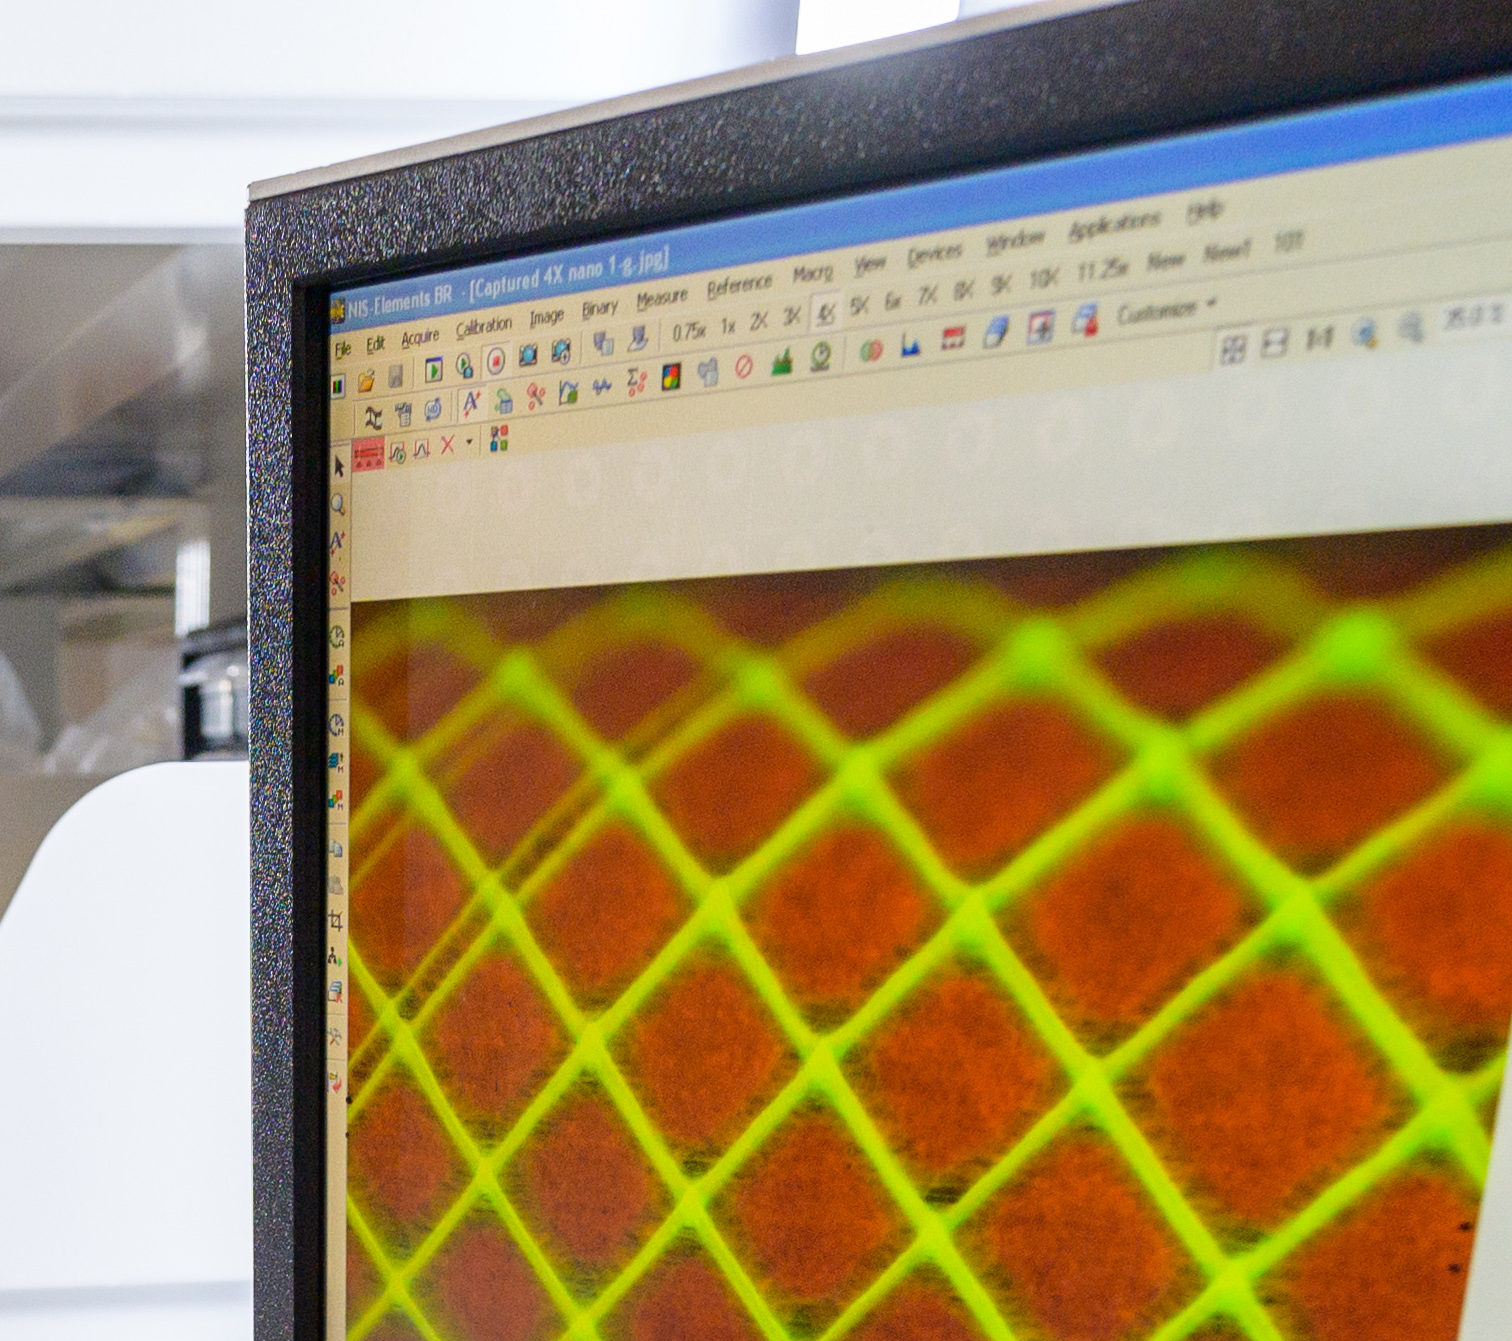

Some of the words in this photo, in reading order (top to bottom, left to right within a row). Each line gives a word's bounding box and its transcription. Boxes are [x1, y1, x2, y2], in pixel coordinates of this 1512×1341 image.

[335, 341, 352, 359] File
[366, 335, 385, 354] Edit
[401, 328, 439, 349] Acquire
[456, 315, 512, 341] Calibration
[530, 308, 564, 329] Image
[582, 298, 619, 321] Binary
[637, 286, 688, 312] Measure
[708, 274, 772, 300] Reference
[793, 264, 834, 284] Macro
[854, 255, 887, 279] View
[907, 242, 963, 268] Devices
[985, 228, 1046, 257] Window
[1067, 209, 1162, 244] Applications
[347, 290, 431, 319] NIS-Elements
[434, 283, 453, 304] BR
[469, 268, 539, 304] [Captured
[543, 264, 563, 284] 4X
[568, 262, 603, 283] nano
